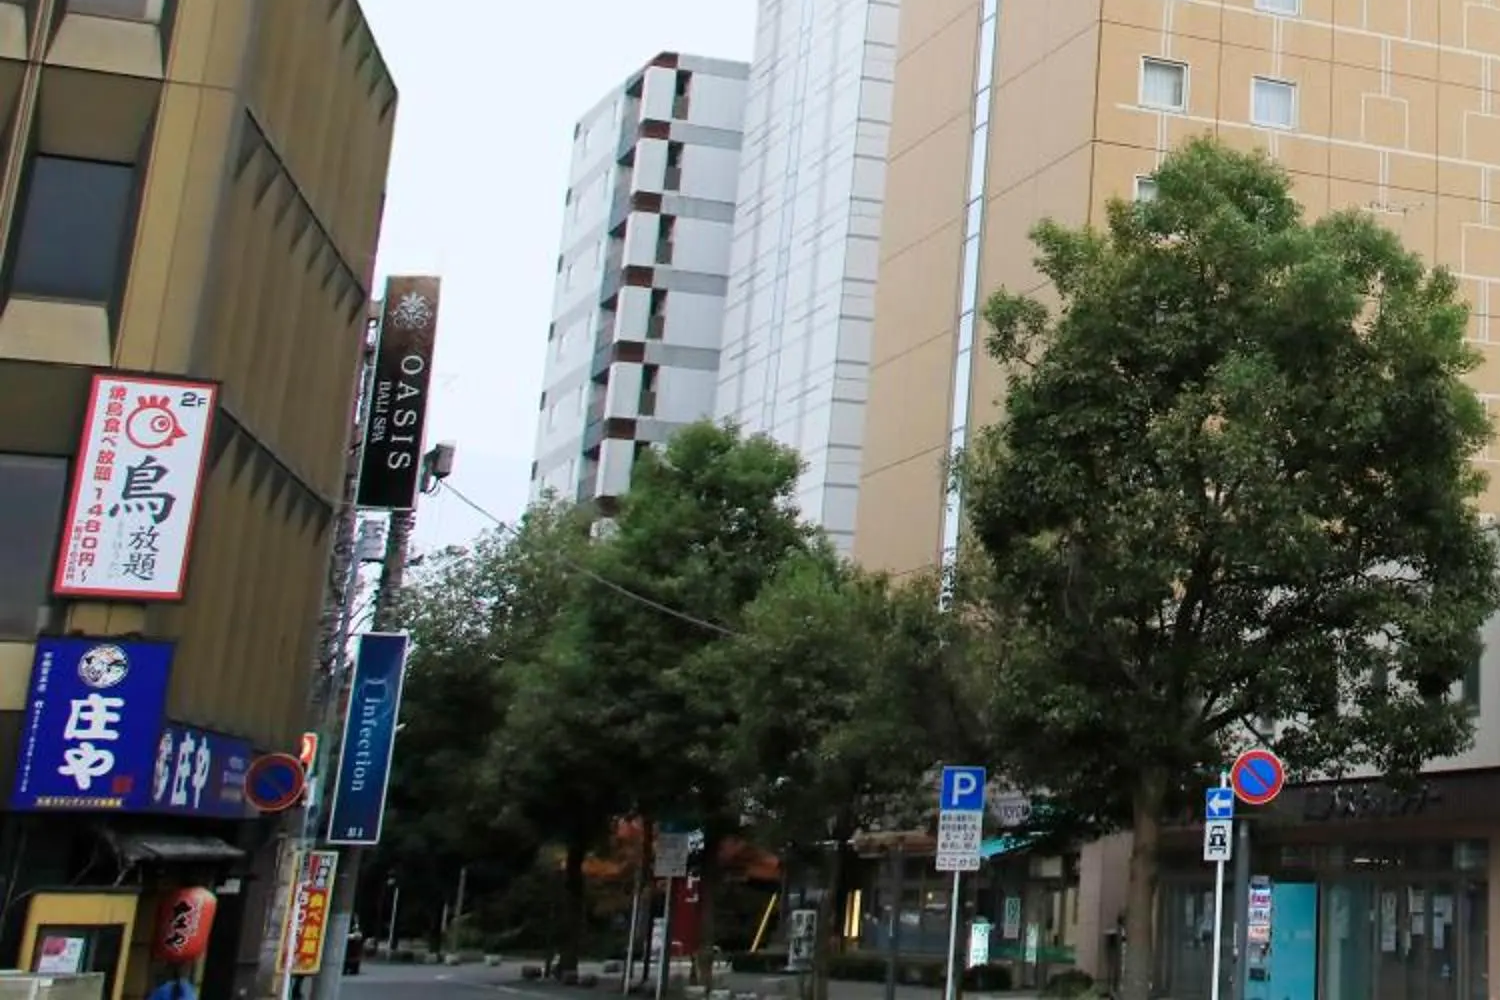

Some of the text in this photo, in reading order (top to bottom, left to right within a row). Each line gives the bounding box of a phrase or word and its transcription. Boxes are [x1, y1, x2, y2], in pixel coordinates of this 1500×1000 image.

[180, 391, 206, 408] 2F
[387, 355, 425, 469] OASIS
[58, 693, 125, 790] 庄や
[951, 772, 977, 806] P
